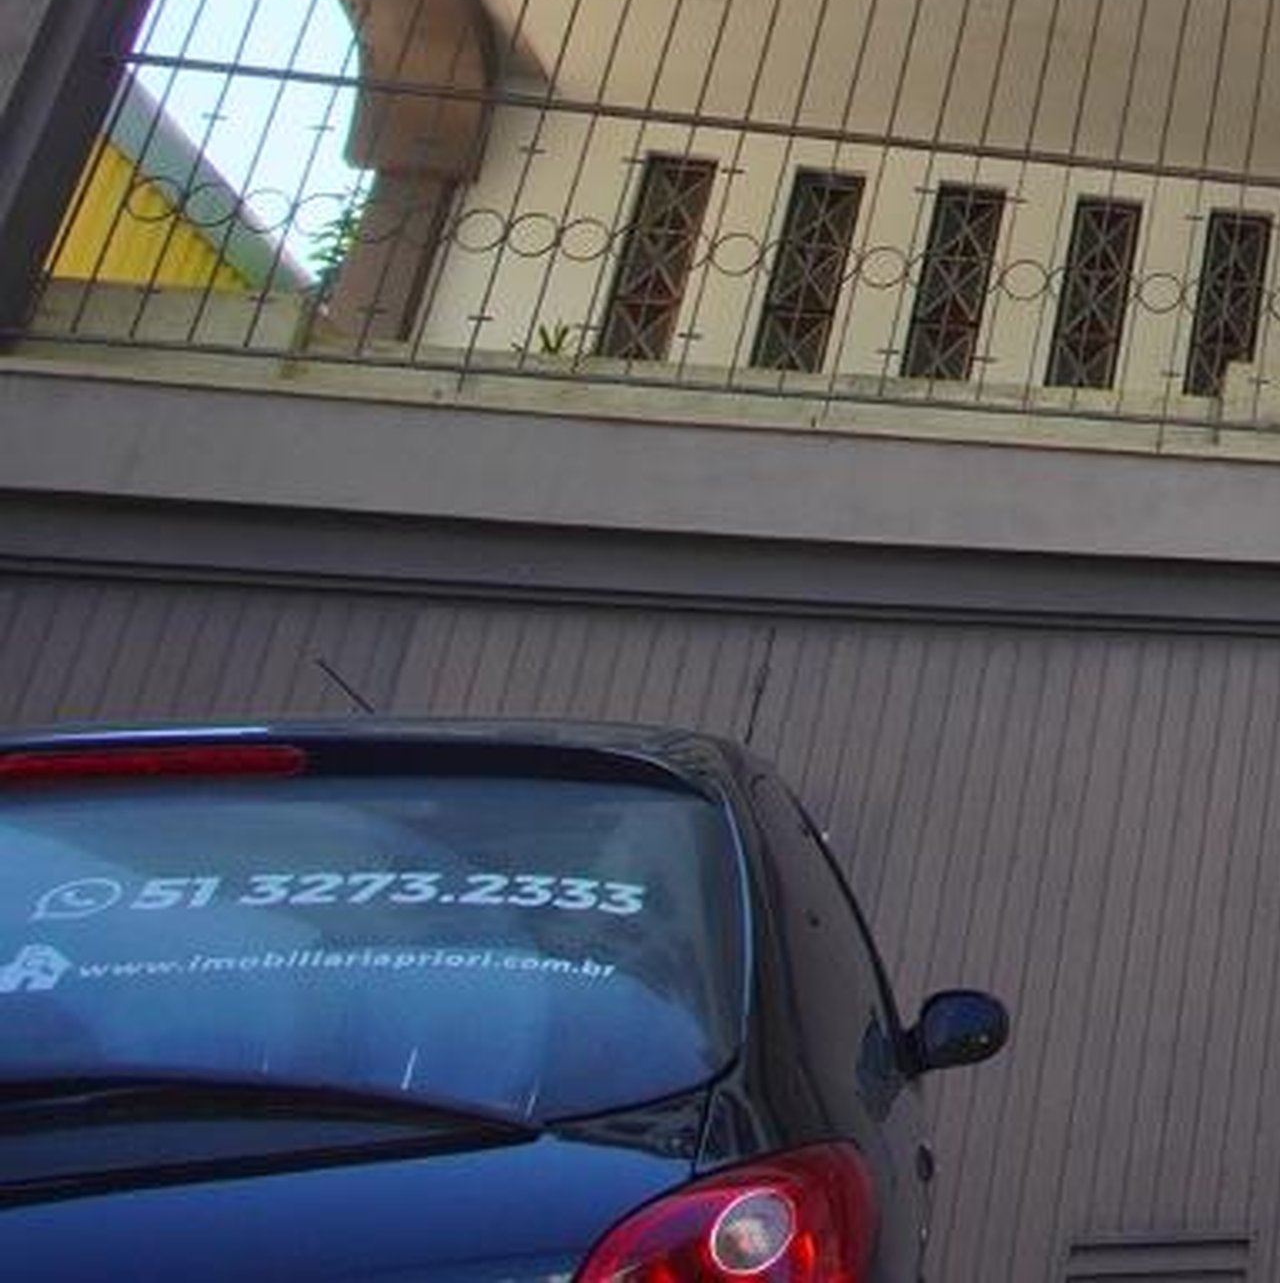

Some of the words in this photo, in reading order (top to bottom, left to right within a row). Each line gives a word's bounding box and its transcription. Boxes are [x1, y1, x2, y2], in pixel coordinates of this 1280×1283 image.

[130, 877, 220, 910] 51
[239, 872, 646, 915] 3273.2333
[80, 948, 616, 978] www.imobiliariapriori.com.br
